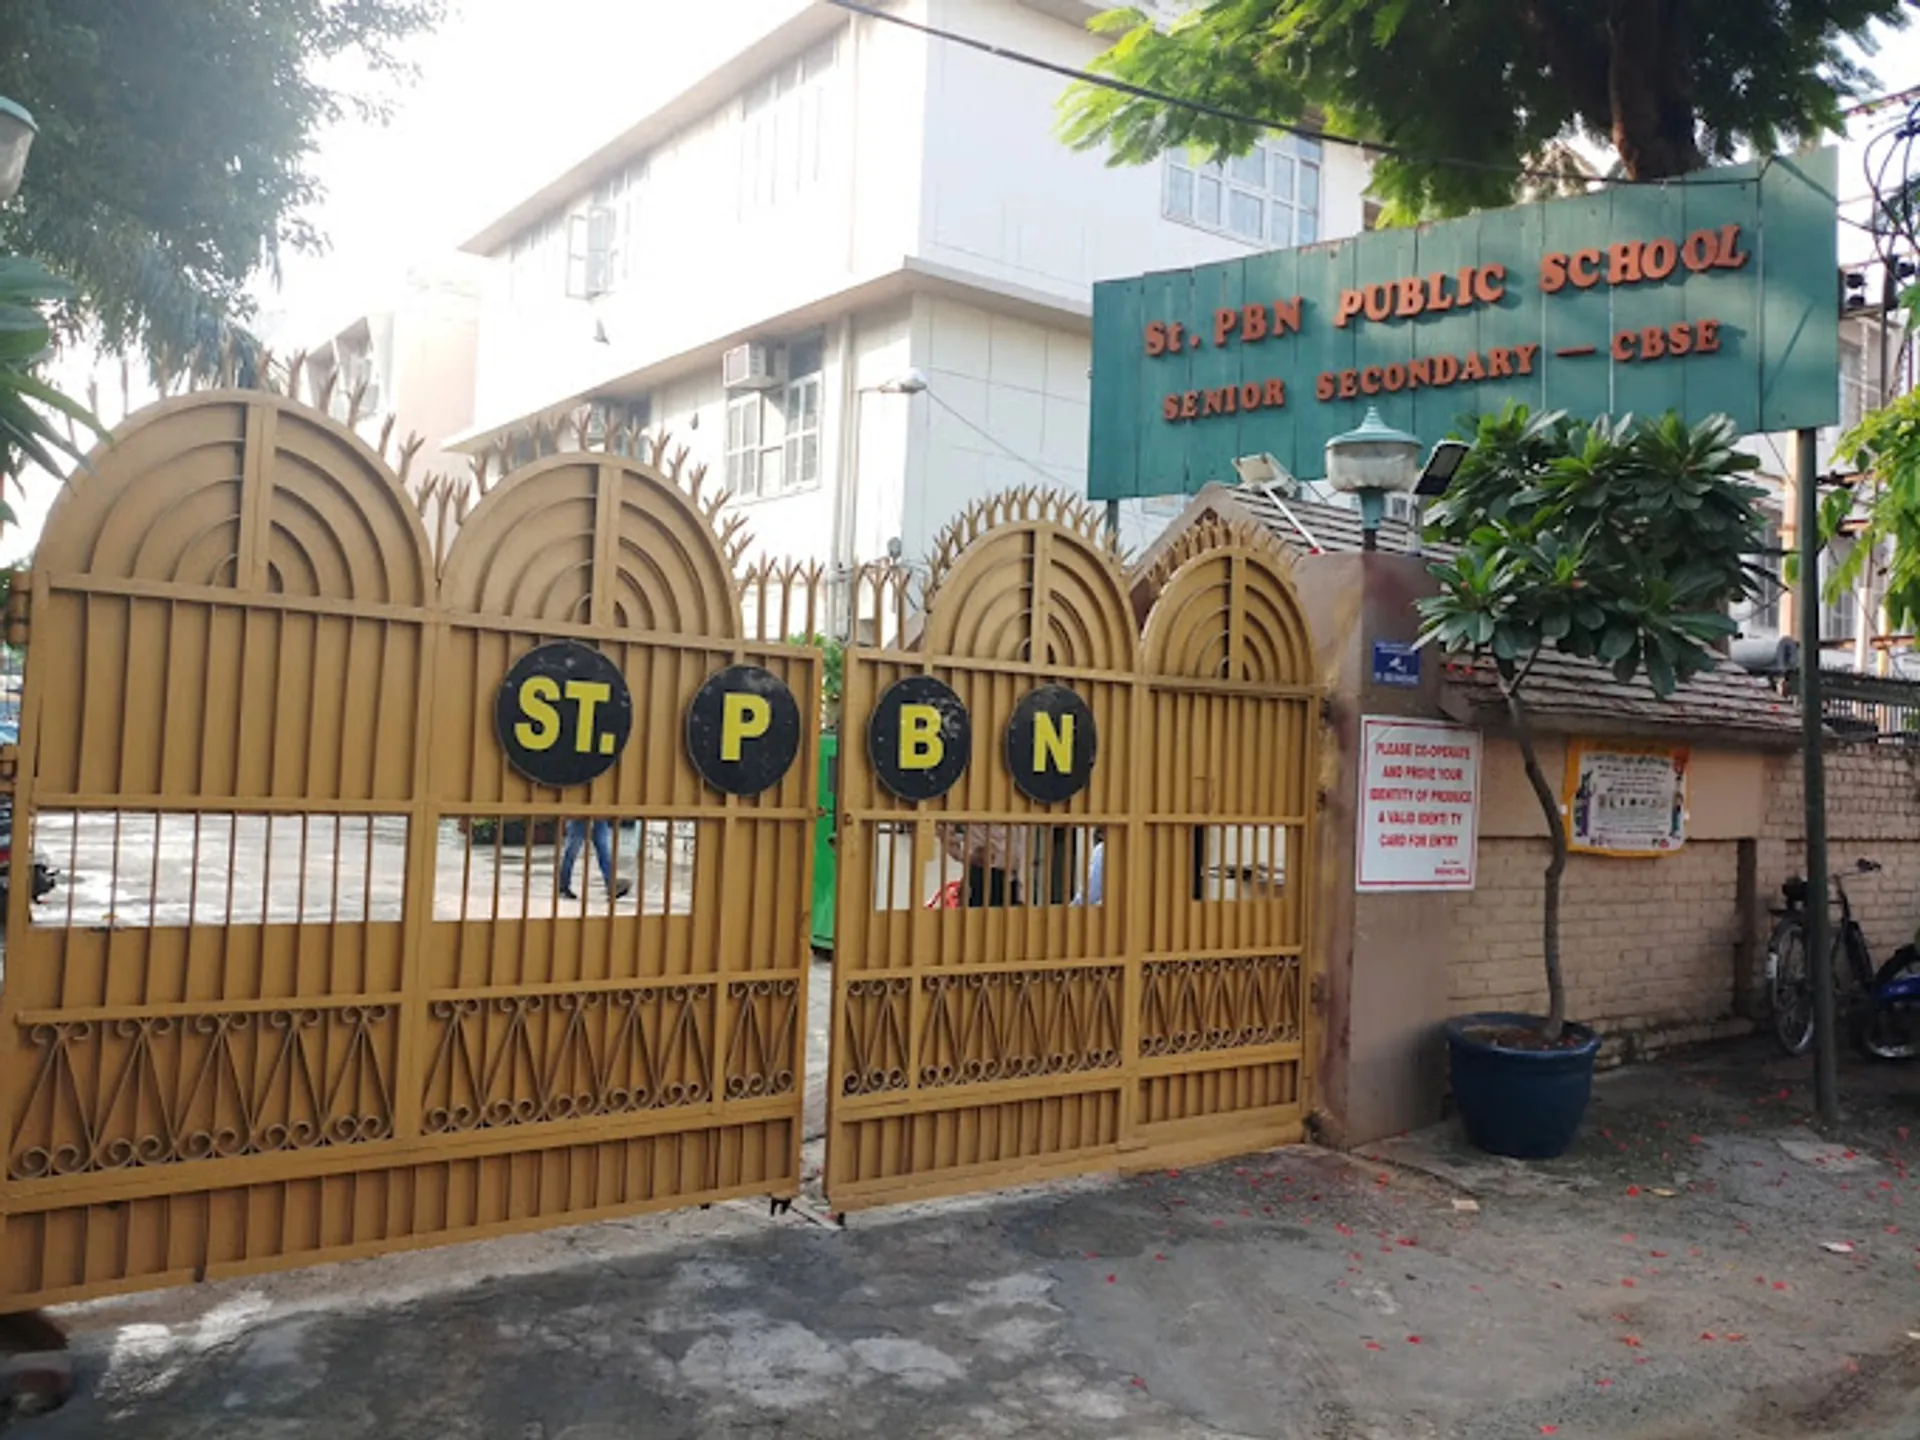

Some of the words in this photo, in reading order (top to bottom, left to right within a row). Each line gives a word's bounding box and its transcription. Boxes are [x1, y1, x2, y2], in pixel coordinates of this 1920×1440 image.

[1144, 320, 1201, 357] St.
[1214, 296, 1304, 347] PBN
[1334, 264, 1507, 328] PUBLIC
[1539, 224, 1749, 294] SCHOOL
[1163, 378, 1286, 422] SENIOR
[1315, 343, 1540, 401] SECONDARY
[1611, 319, 1721, 363] CBSE
[514, 676, 616, 755] ST.
[720, 692, 771, 761] P
[898, 703, 944, 770] B
[1032, 711, 1075, 774] N
[1375, 743, 1412, 757] PLEASE
[1383, 766, 1402, 778] AND
[1405, 766, 1435, 780] PROVE
[1438, 768, 1463, 781] YOUR
[1369, 788, 1413, 801] IDENTITY
[1387, 811, 1415, 825] VALID
[1379, 834, 1406, 848] CARD
[1409, 834, 1427, 848] FOR
[1428, 835, 1458, 848] ENTRY
